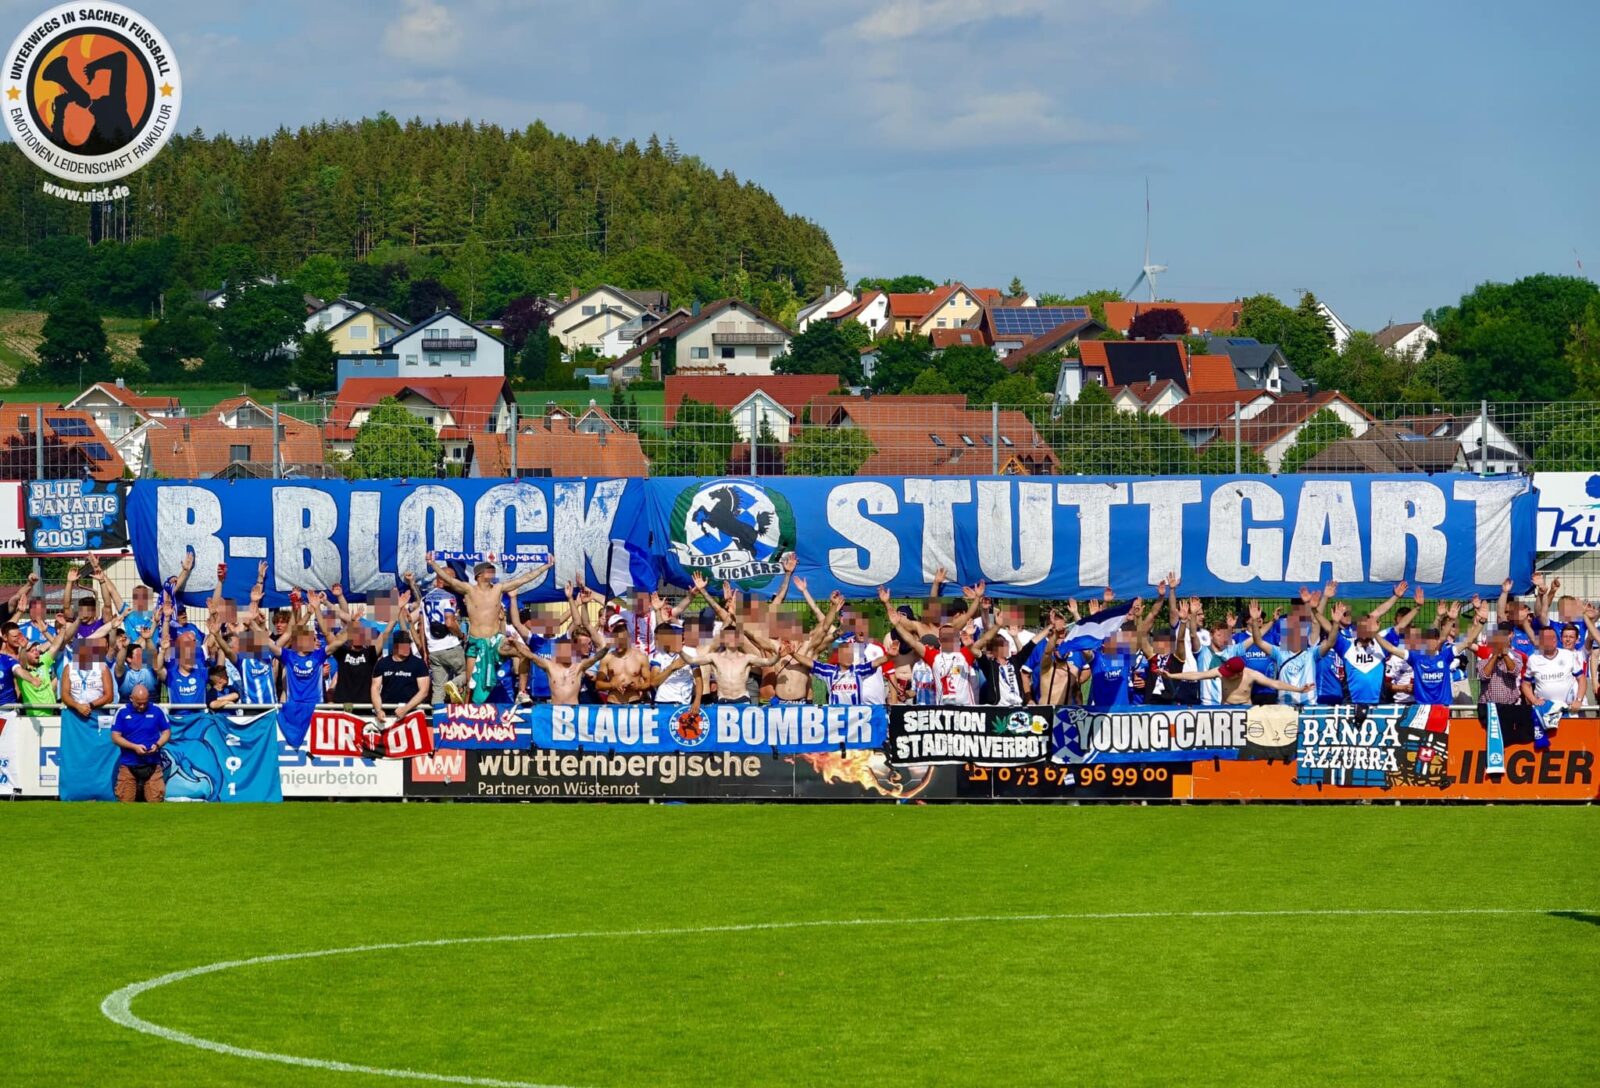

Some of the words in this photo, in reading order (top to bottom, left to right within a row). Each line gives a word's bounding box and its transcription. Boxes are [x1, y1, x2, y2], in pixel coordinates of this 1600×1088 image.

[32, 482, 81, 499] BLUE
[31, 497, 116, 515] FANATIC
[61, 514, 104, 530] SEIT
[37, 530, 85, 548] 2009
[827, 477, 1529, 588] STUTTGART
[690, 552, 731, 566] FORZA
[718, 563, 782, 579] KICKERS
[552, 705, 660, 744] BLAUE
[717, 705, 872, 746] BOMBER
[904, 710, 986, 732] SEKTION
[1077, 714, 1169, 752] YOUNG
[1173, 712, 1248, 749] CARE
[1303, 719, 1401, 747] BANDA
[896, 734, 1050, 758] STADIONVERBOT
[415, 750, 463, 775] W&W
[478, 749, 762, 784] württembergische
[1302, 746, 1399, 772] AZZURRA
[280, 770, 378, 785] nieurbeton
[1112, 767, 1138, 786] 99
[478, 781, 530, 796] Partner
[535, 784, 560, 796] von
[564, 781, 640, 796] Wüstenrot
